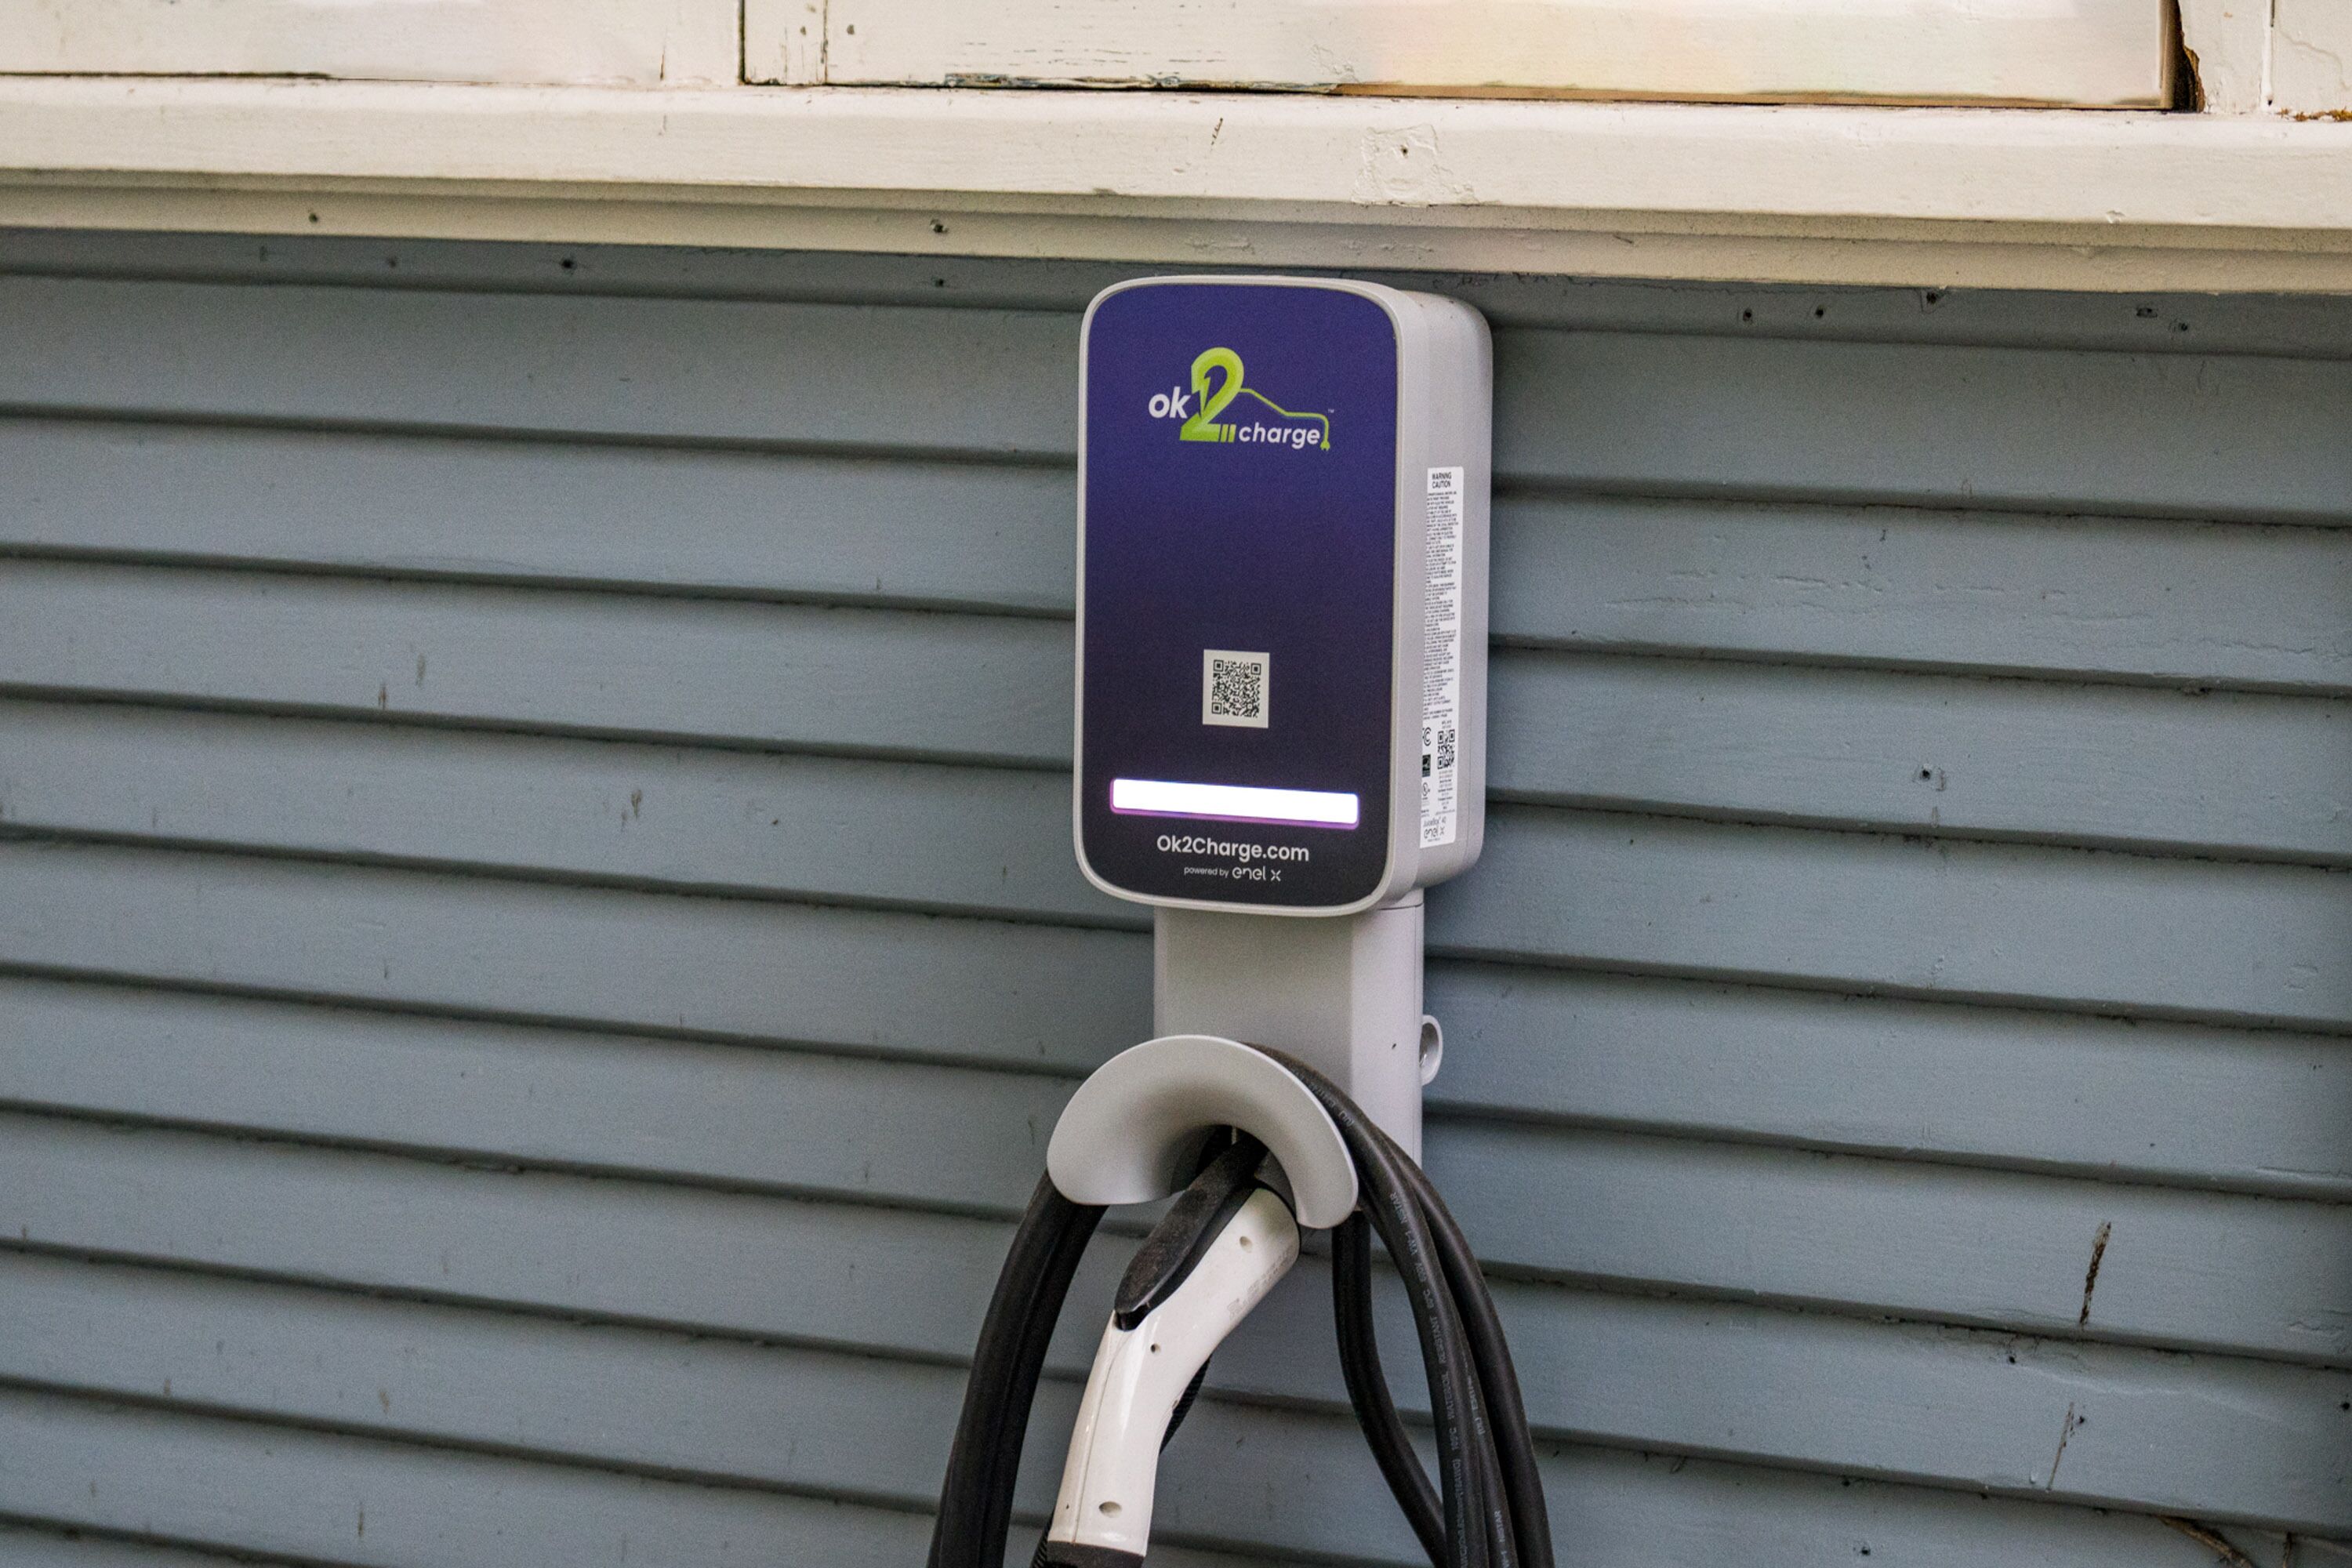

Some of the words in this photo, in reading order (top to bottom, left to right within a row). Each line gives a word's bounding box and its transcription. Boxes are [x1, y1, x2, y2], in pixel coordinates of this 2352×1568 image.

[1239, 422, 1320, 449] charge
[1432, 480, 1451, 488] CAUTION
[1156, 834, 1309, 862] Ok2Charge.com
[1184, 866, 1218, 876] powered
[1219, 867, 1229, 878] by
[1232, 866, 1266, 881] enel
